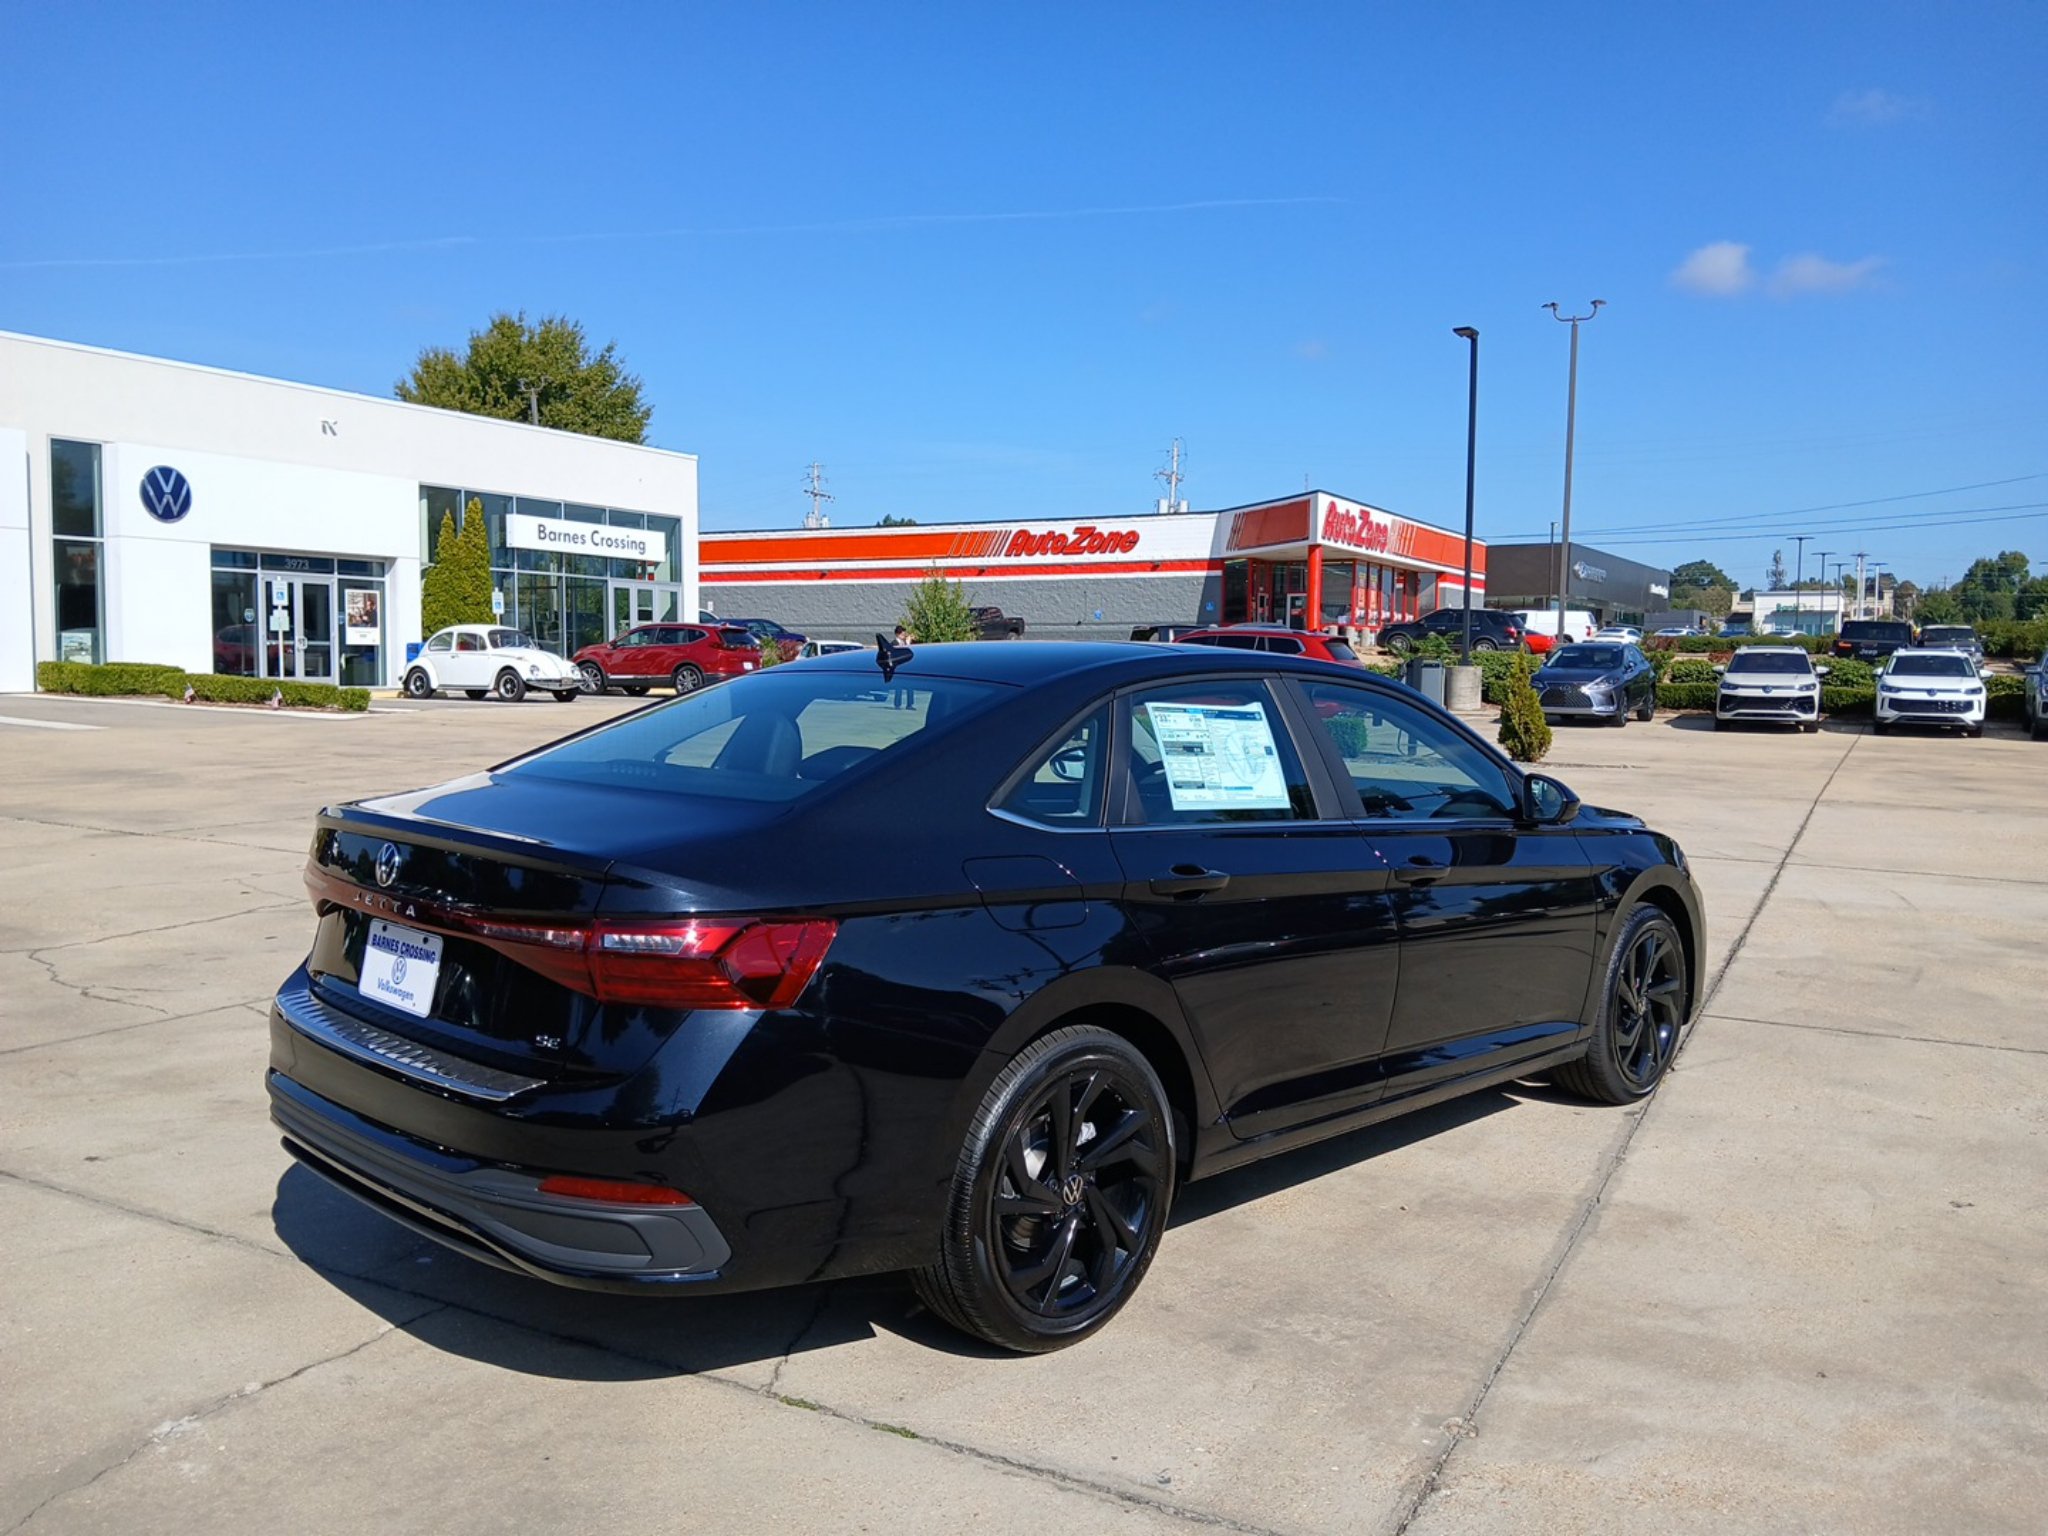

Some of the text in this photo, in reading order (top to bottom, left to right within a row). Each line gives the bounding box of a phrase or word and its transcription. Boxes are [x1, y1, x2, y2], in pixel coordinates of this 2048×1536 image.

[537, 523, 647, 555] Barnes Crossing
[1321, 500, 1389, 553] AutoZone
[1003, 526, 1140, 557] AutoZone
[284, 558, 310, 570] 3973
[353, 891, 416, 917] JETTA
[371, 933, 436, 965] BARNES CROSSING
[377, 977, 414, 1001] Volkswagen
[535, 1034, 561, 1050] SE
